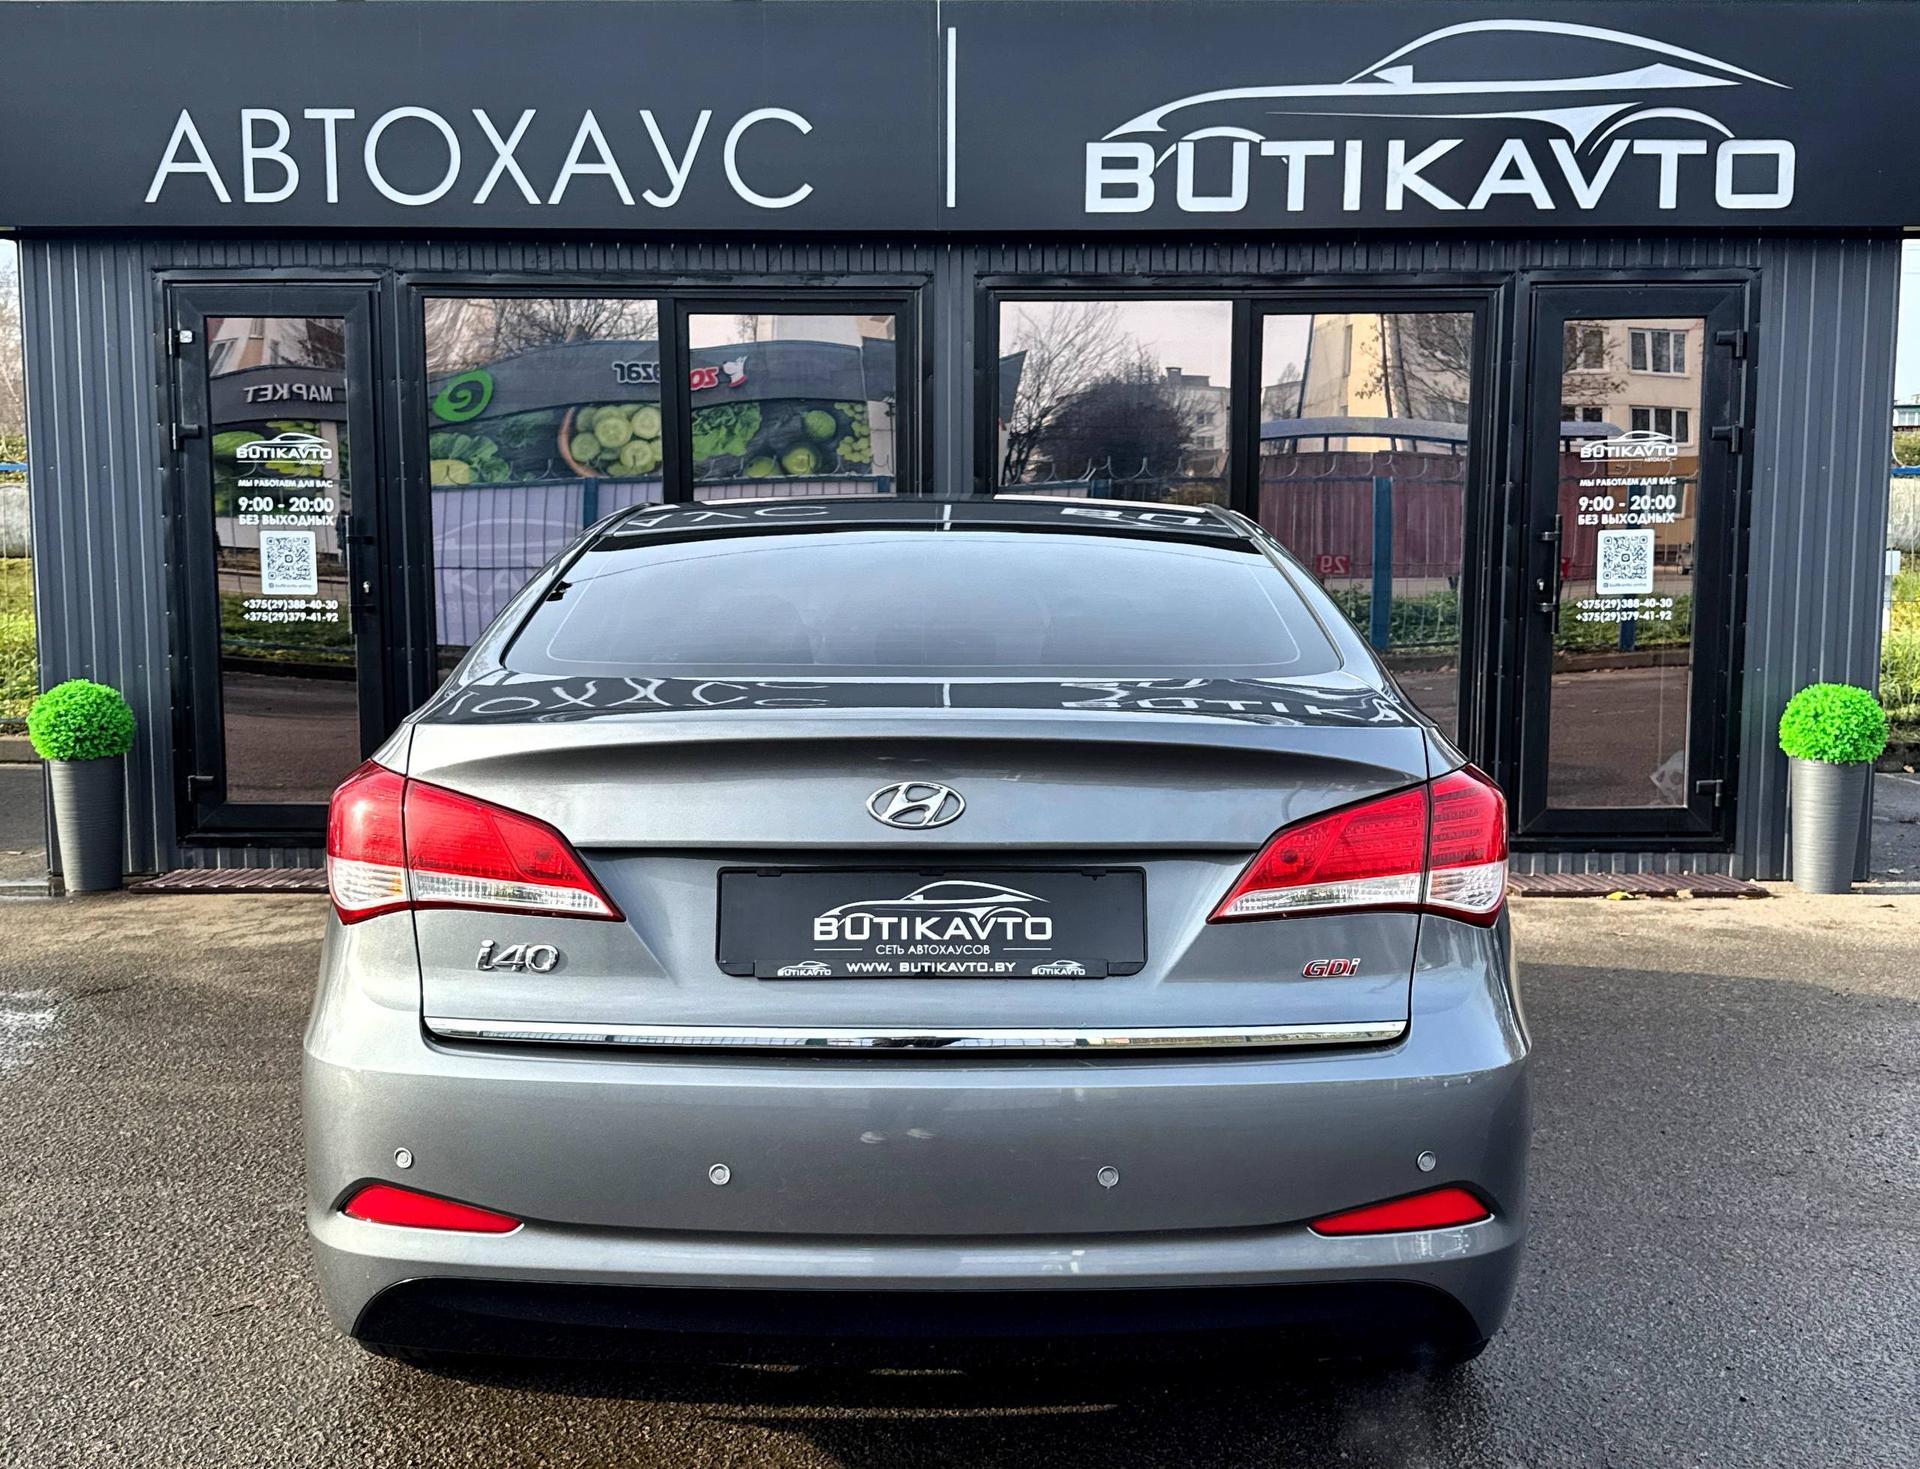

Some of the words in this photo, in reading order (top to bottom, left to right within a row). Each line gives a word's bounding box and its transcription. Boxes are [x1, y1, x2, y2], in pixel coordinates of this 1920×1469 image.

[145, 106, 814, 208] АВТОХАУС
[1085, 138, 1797, 213] BUTIKAVTO
[236, 446, 333, 459] BUTIKAVTO
[1580, 444, 1678, 458] BUTIKAVTO
[238, 479, 253, 487] МЫ
[254, 479, 297, 487] РАБОТАЕМ
[297, 480, 315, 488] ДЛЯ
[316, 480, 333, 488] ВАС
[1579, 479, 1594, 487] МЫ
[1596, 478, 1639, 486] РАБОТАЕМ
[1640, 477, 1658, 486] ДЛЯ
[1659, 477, 1677, 485] ВАС
[238, 497, 273, 512] 9:00
[289, 497, 334, 512] 20:00
[1578, 496, 1614, 511] 9:00
[1630, 495, 1676, 511] 20:00
[239, 514, 259, 525] БЕЗ
[262, 514, 334, 526] ВЫХОДНЫХ
[1578, 514, 1599, 525] БЕЗ
[1601, 513, 1675, 525] ВЫХОДНЫХ
[242, 600, 338, 610] +375(29)388-40-30
[1576, 598, 1673, 610] +375(29)388-40-30
[242, 612, 339, 623] +375(29)379-41-92
[1576, 611, 1672, 623] +375(29)379-41-92
[814, 917, 1052, 941] BUTIKAVTO
[875, 944, 904, 955] СЕТЬ
[907, 944, 990, 955] АВТОХАУСОВ
[476, 939, 560, 973] i40
[777, 967, 832, 976] BUTIKAVTO
[846, 962, 893, 973] WWW.
[900, 962, 1016, 973] BUTIKAVTO.BY
[1031, 967, 1086, 976] BUTIKAVTO
[1302, 957, 1361, 978] GDi
